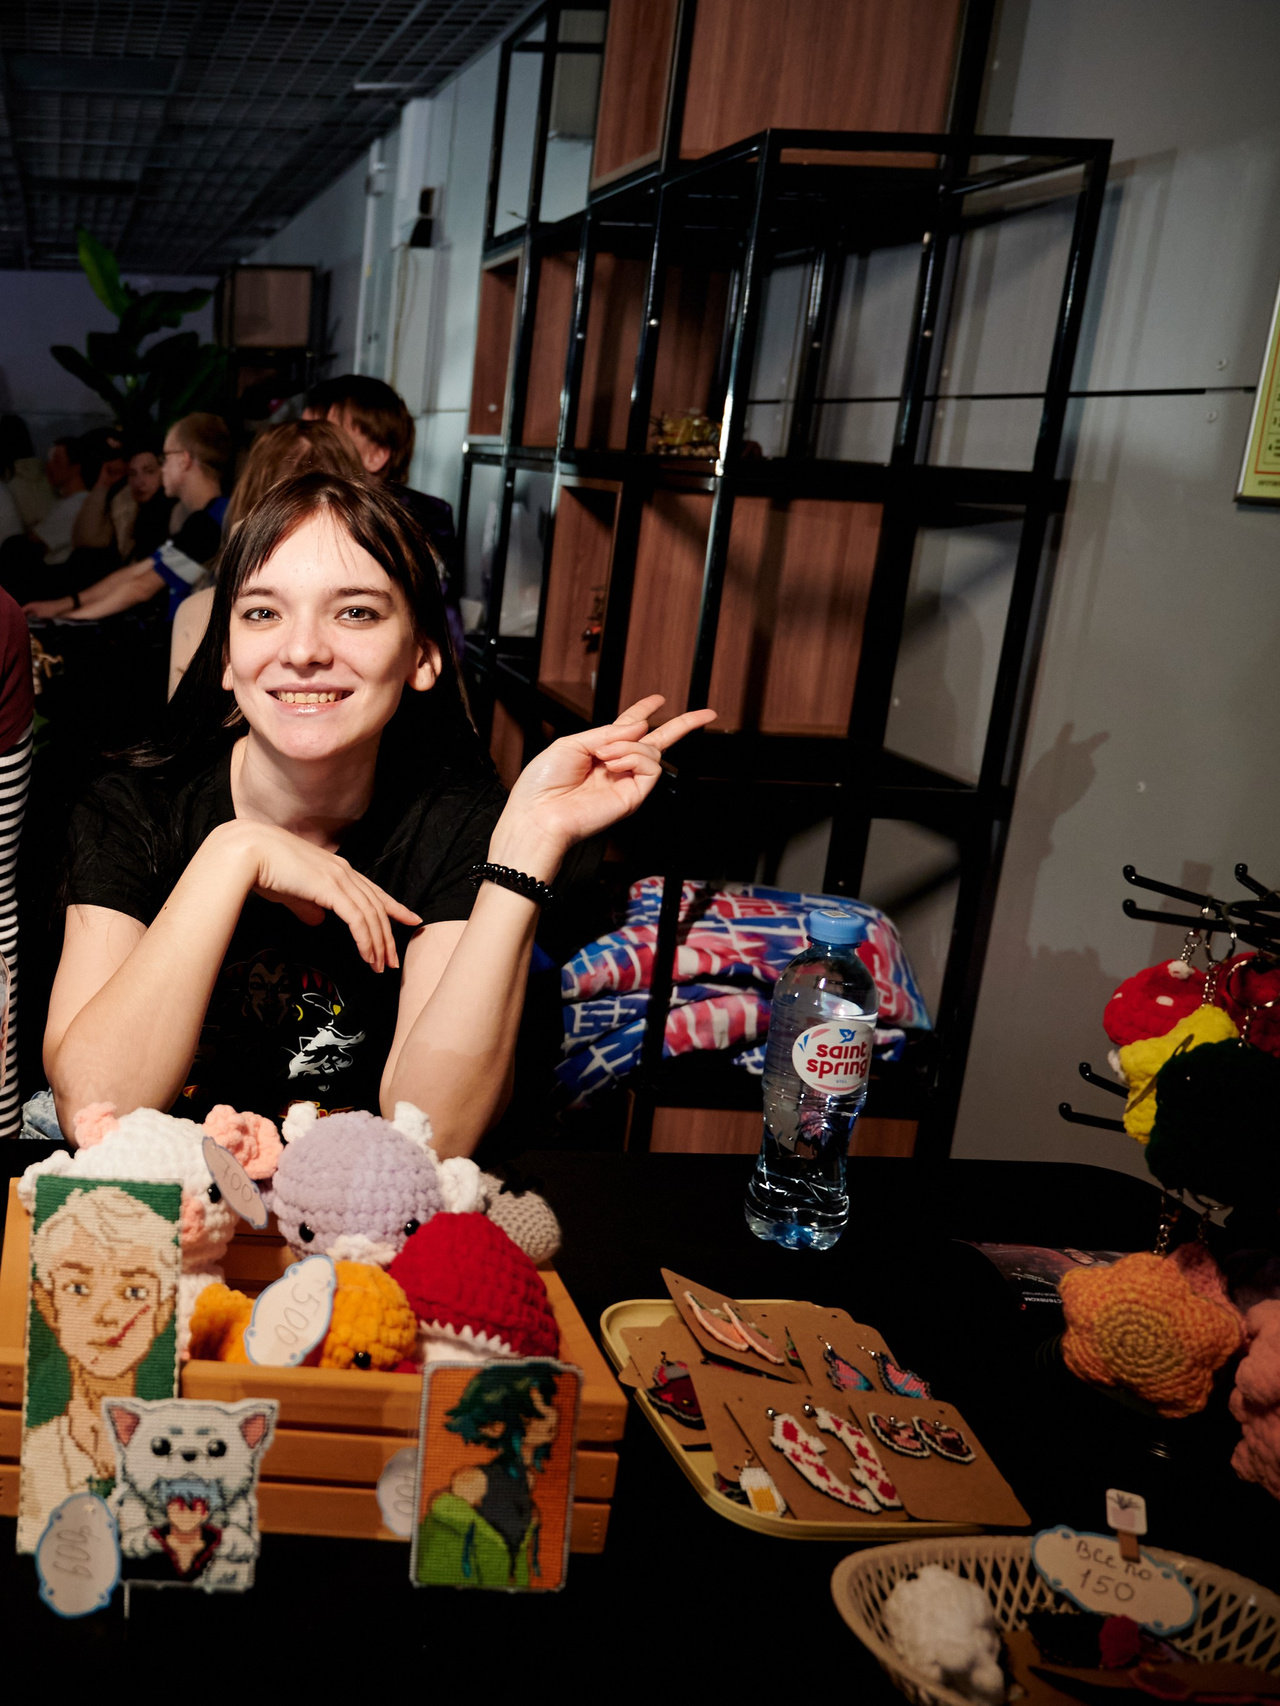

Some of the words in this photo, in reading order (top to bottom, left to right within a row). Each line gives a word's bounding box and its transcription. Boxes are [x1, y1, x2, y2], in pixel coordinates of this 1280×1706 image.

[806, 1058, 869, 1079] spring
[816, 1041, 868, 1060] saint
[219, 1153, 253, 1202] 700
[274, 1282, 320, 1346] 500
[1076, 1540, 1118, 1569] Все
[1124, 1563, 1152, 1581] по
[1081, 1568, 1135, 1602] 150
